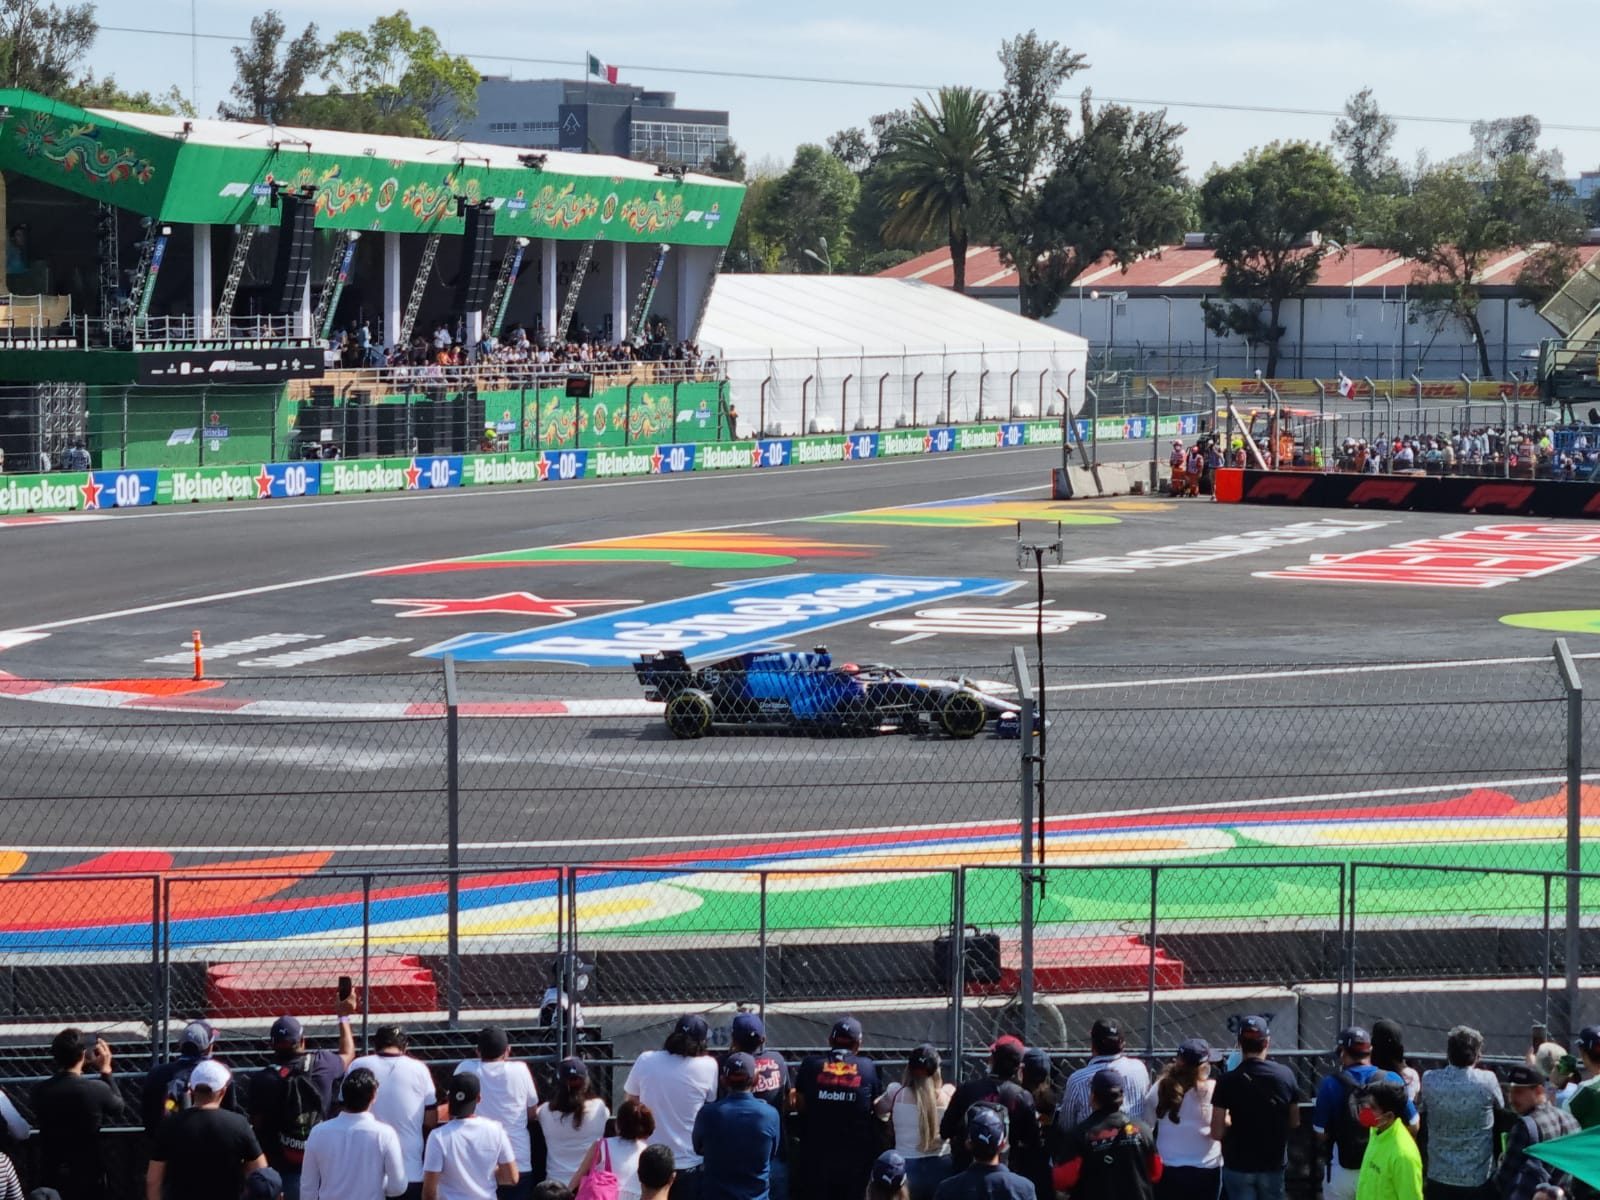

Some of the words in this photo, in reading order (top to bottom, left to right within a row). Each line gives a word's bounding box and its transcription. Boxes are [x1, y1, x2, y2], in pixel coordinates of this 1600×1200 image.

[799, 439, 842, 462] Heineken
[858, 436, 871, 458] 0.0
[885, 433, 923, 453] Heineken
[961, 429, 996, 448] Heineken
[474, 455, 535, 483] Heineken
[559, 453, 576, 478] 0.0
[596, 451, 649, 475] Heineken
[670, 448, 685, 471] 0.0
[703, 443, 750, 468] Heineken
[769, 442, 783, 465] 0.0
[172, 470, 253, 500] Heineken
[285, 466, 306, 496] 0.0
[333, 464, 403, 492] Heineken
[431, 459, 449, 487] 0.0
[0, 479, 78, 511] eineken
[116, 474, 140, 506] 0.0
[492, 577, 963, 658] Heineken
[818, 1090, 846, 1101] Mobil
